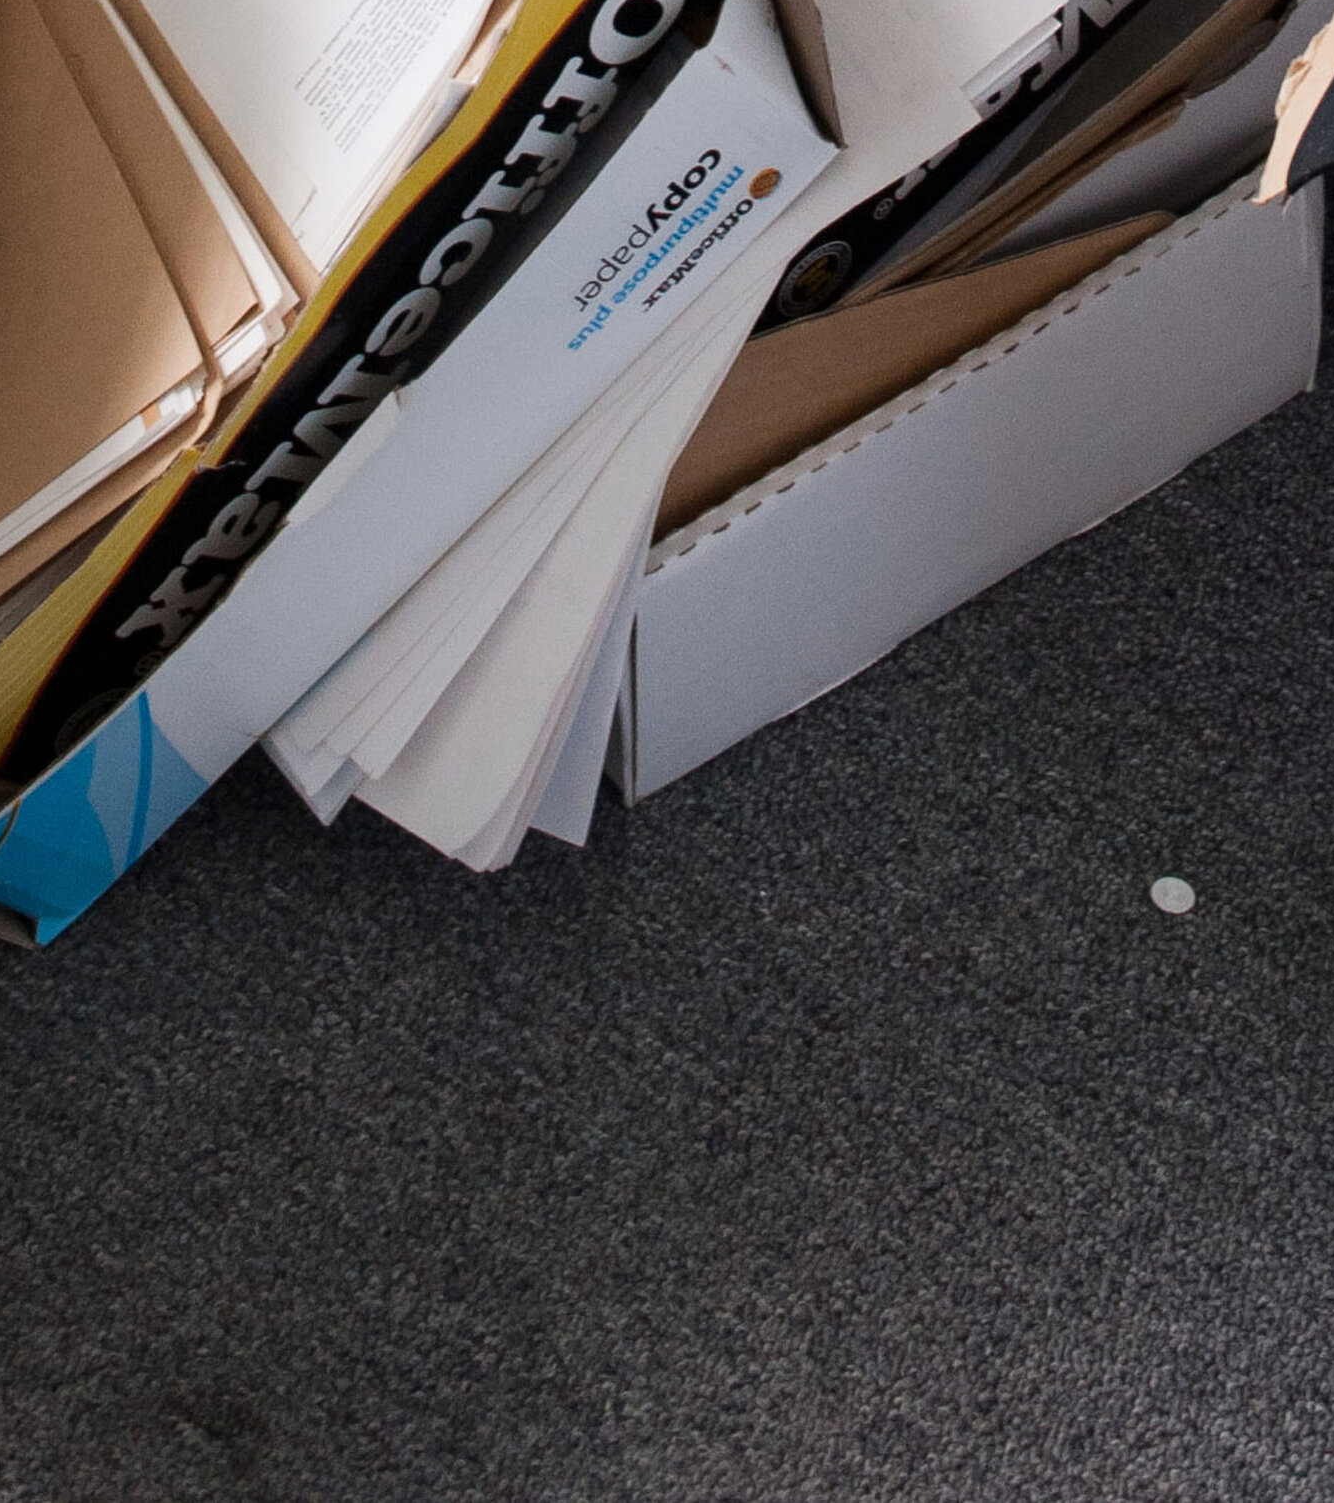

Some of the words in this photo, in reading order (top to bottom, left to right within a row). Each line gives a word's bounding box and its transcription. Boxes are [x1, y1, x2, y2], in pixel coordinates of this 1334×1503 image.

[574, 147, 723, 315] copypaper
[604, 163, 747, 330] multipurpose
[640, 195, 755, 315] OfficeMax
[565, 309, 607, 354] plus
